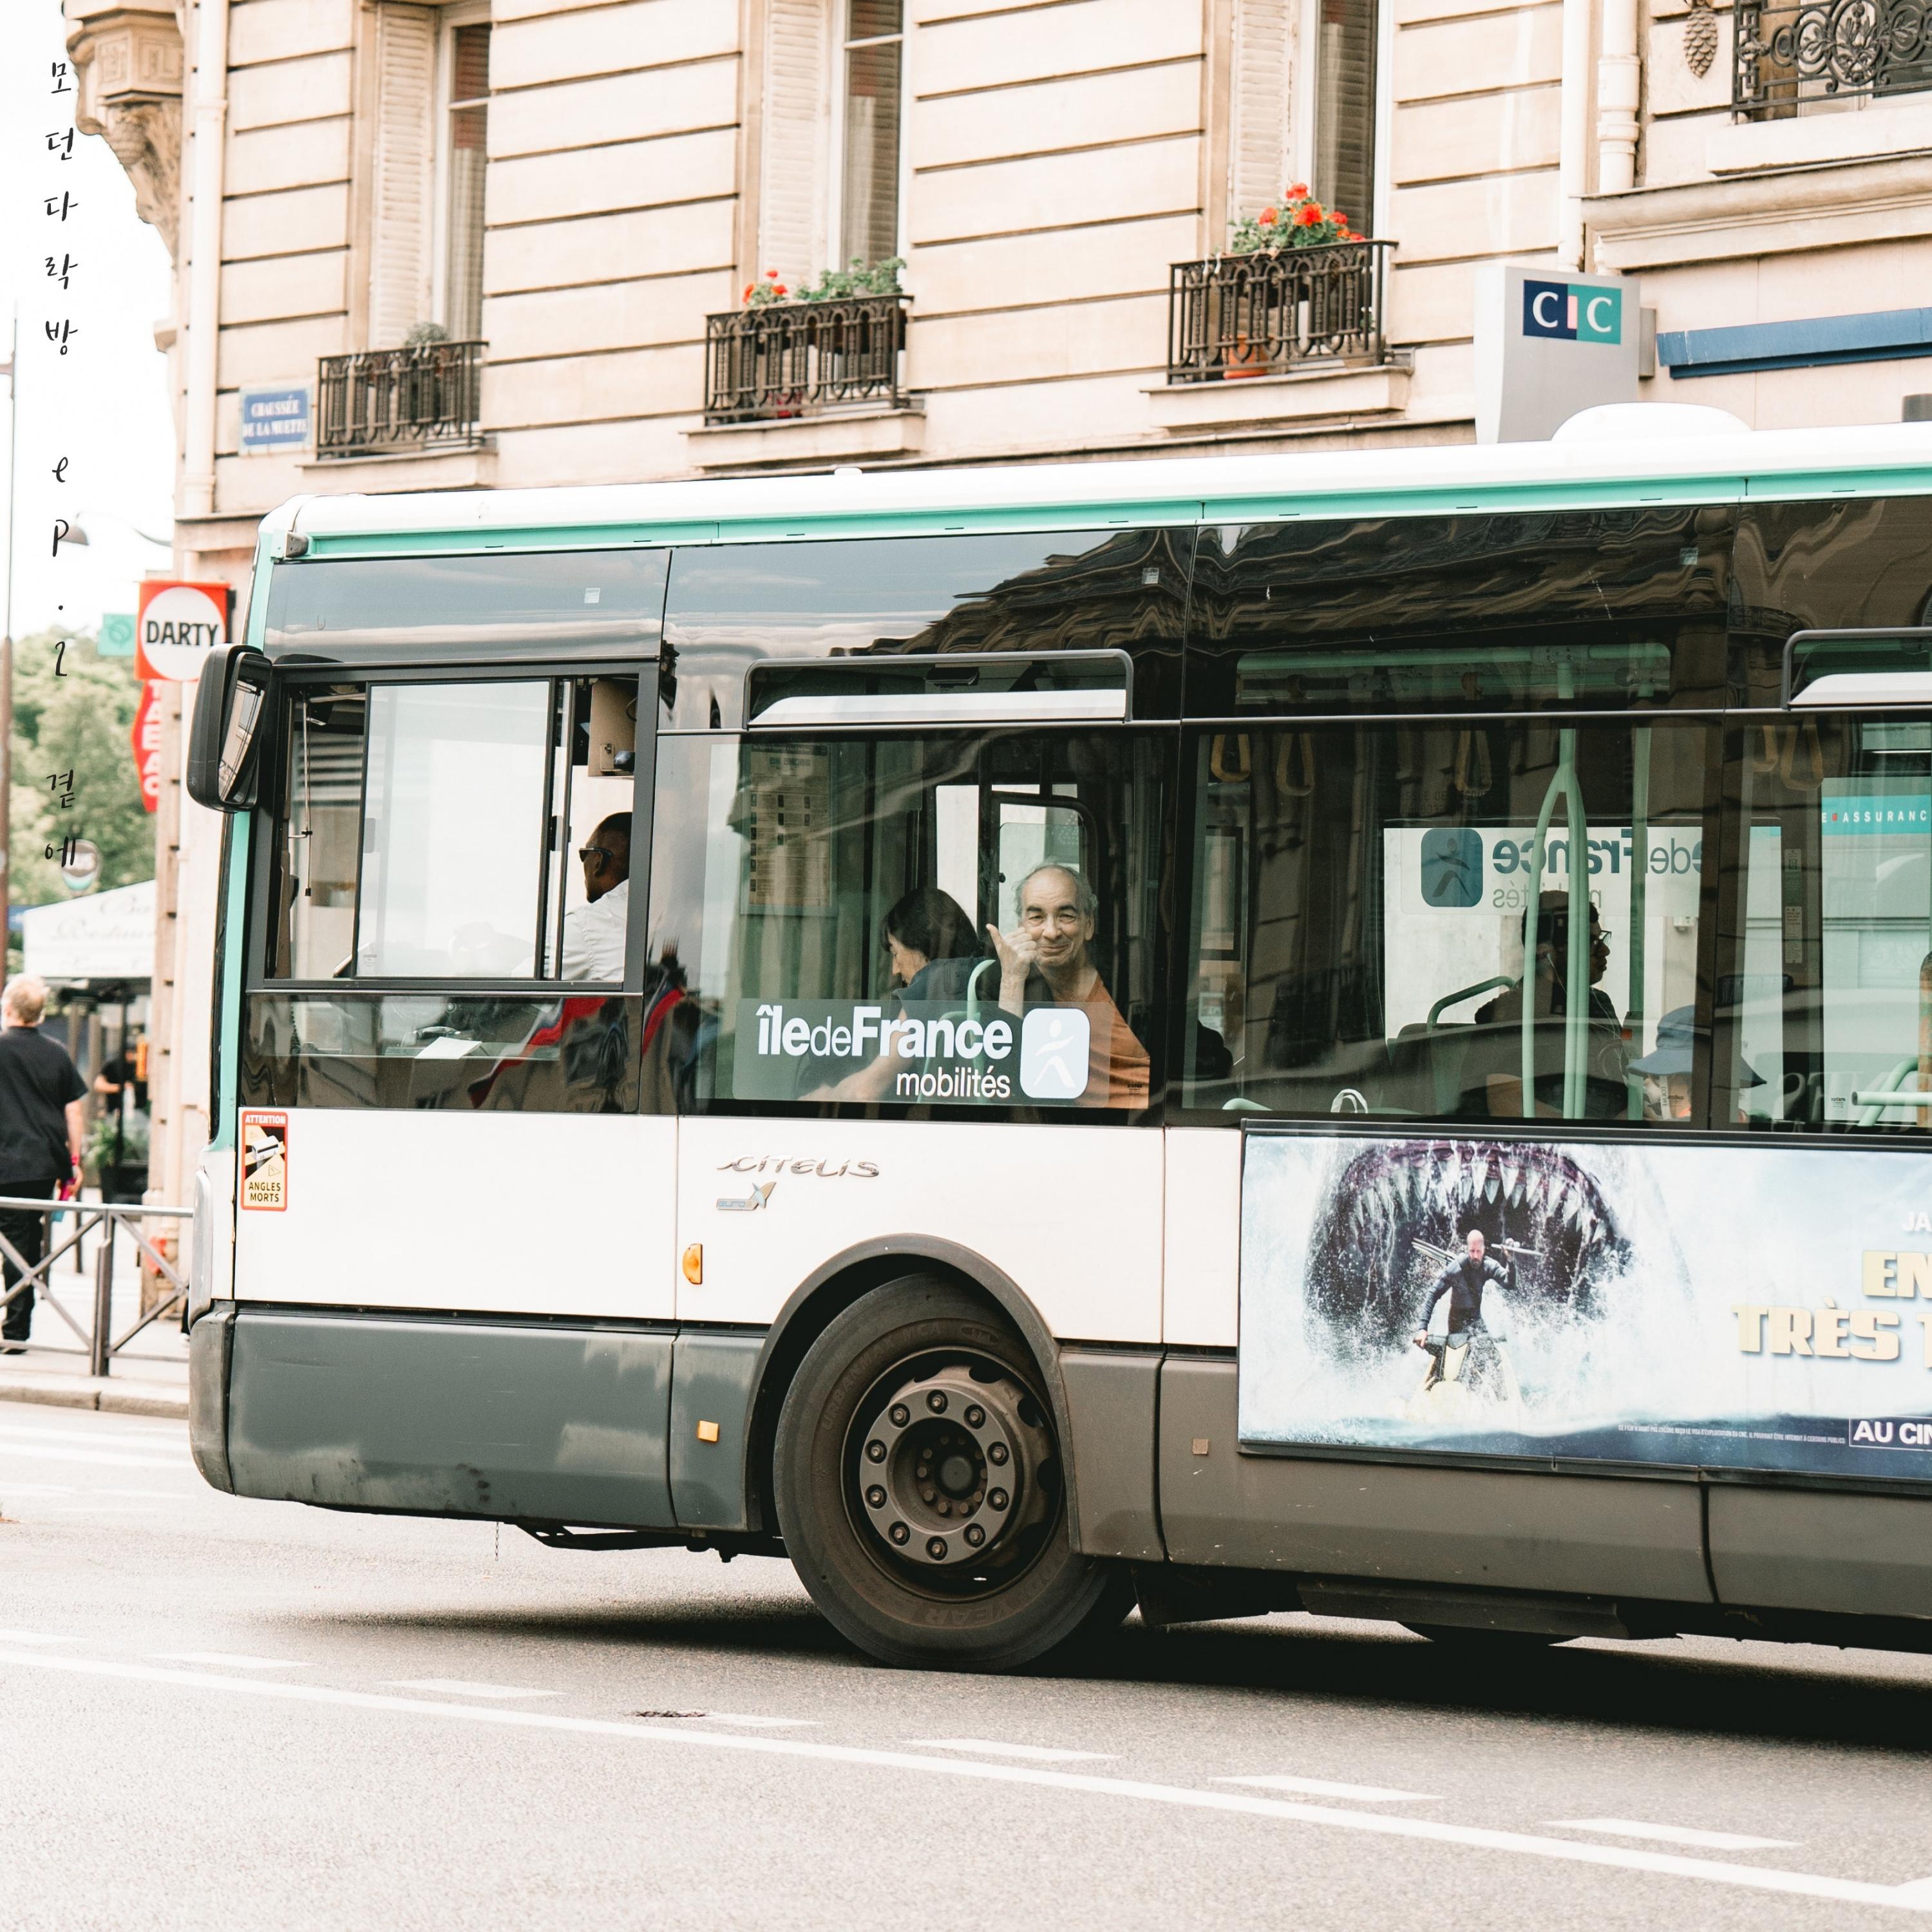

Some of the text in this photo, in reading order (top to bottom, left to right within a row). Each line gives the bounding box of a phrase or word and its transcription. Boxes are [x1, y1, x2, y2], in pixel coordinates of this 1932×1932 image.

[1532, 291, 1613, 333] CIC
[147, 620, 219, 647] DARTY
[1842, 810, 1927, 822] ASSURANC
[896, 1066, 1011, 1099] mobilités
[245, 1115, 285, 1124] ATTENTION
[249, 1182, 281, 1191] ANGLES
[250, 1193, 279, 1202] MORTS
[1862, 1250, 1932, 1298] EN
[1731, 1297, 1899, 1361] TRÈS
[1853, 1420, 1893, 1443] AU
